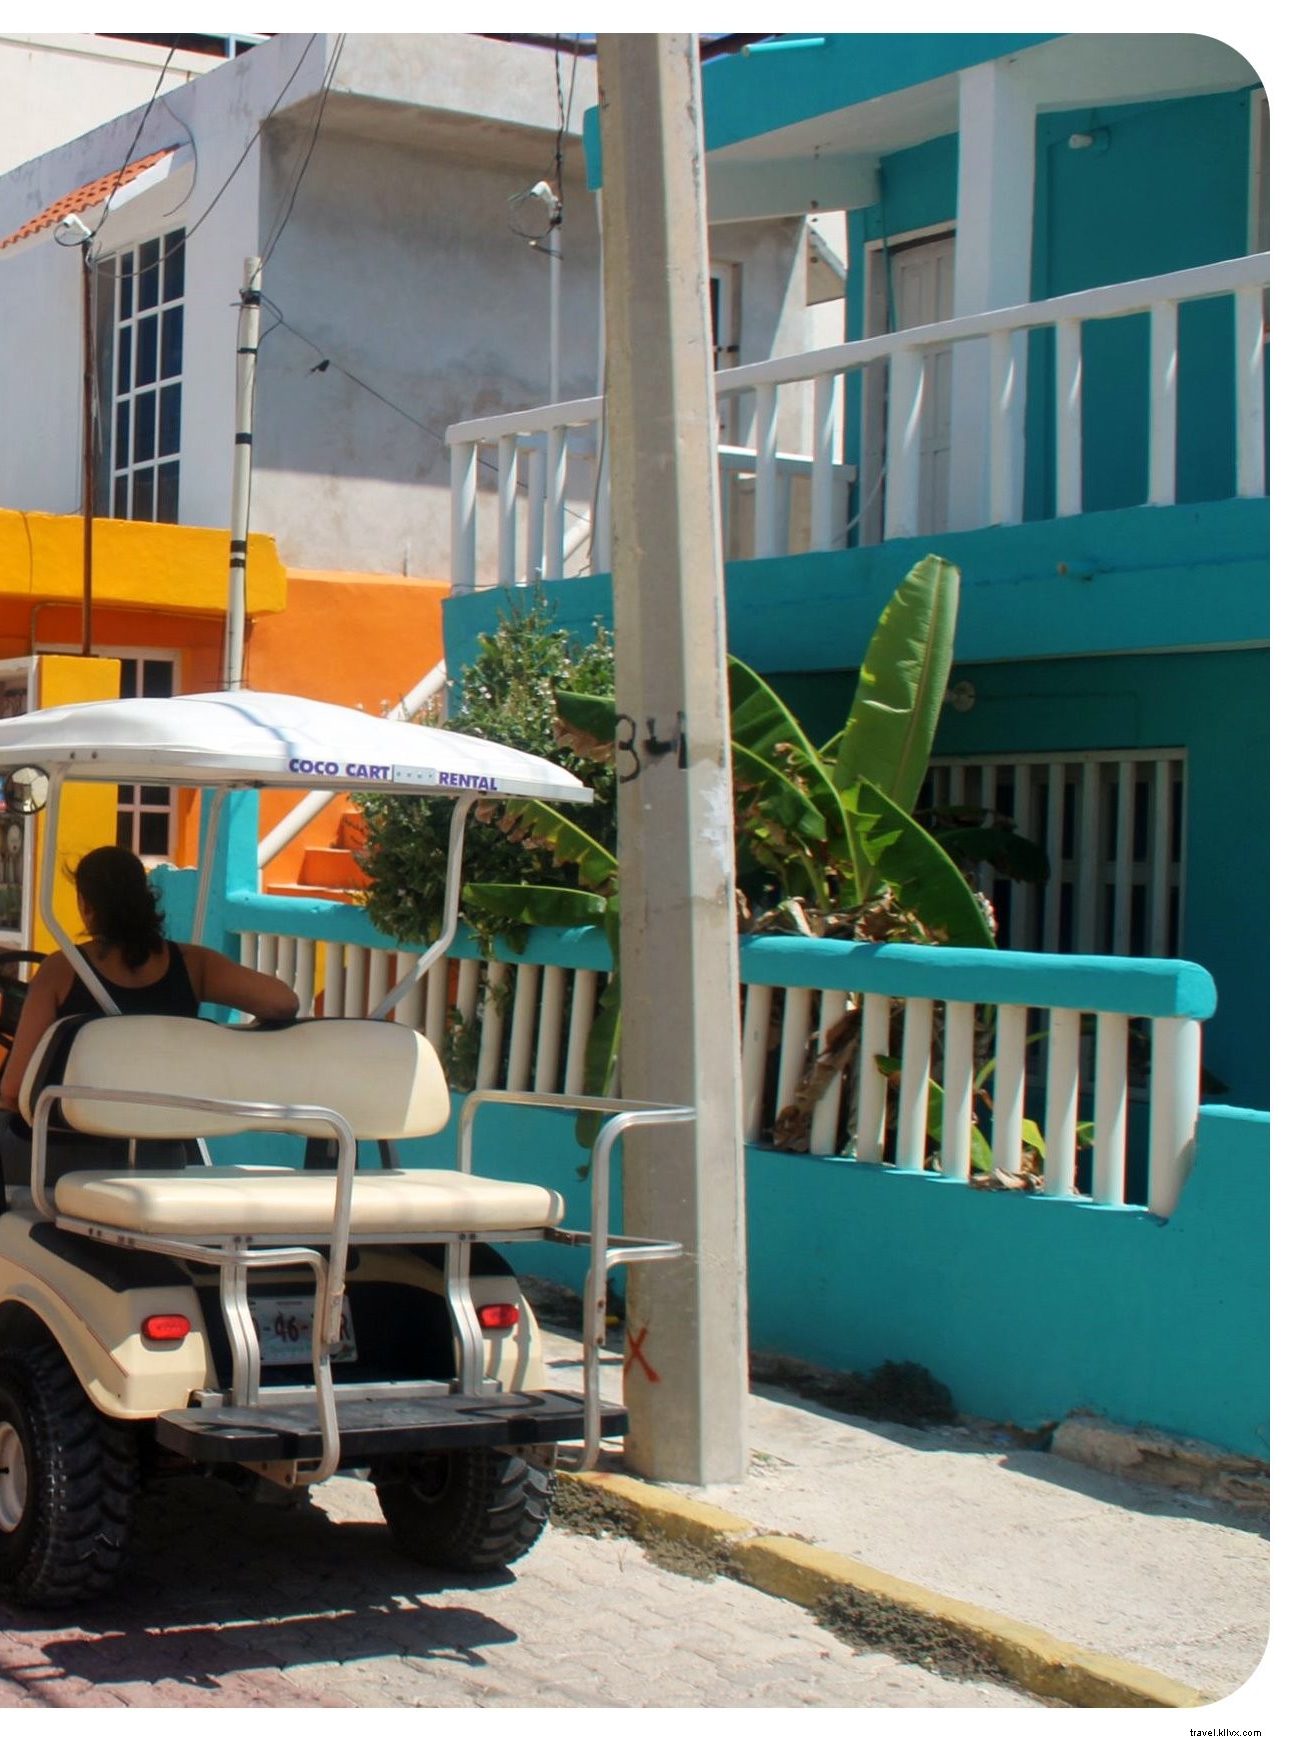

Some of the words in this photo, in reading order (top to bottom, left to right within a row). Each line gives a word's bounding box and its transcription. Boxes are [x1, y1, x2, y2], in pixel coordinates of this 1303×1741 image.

[289, 758, 339, 775] COCO
[345, 763, 390, 780] CART
[439, 771, 498, 791] RENTAL
